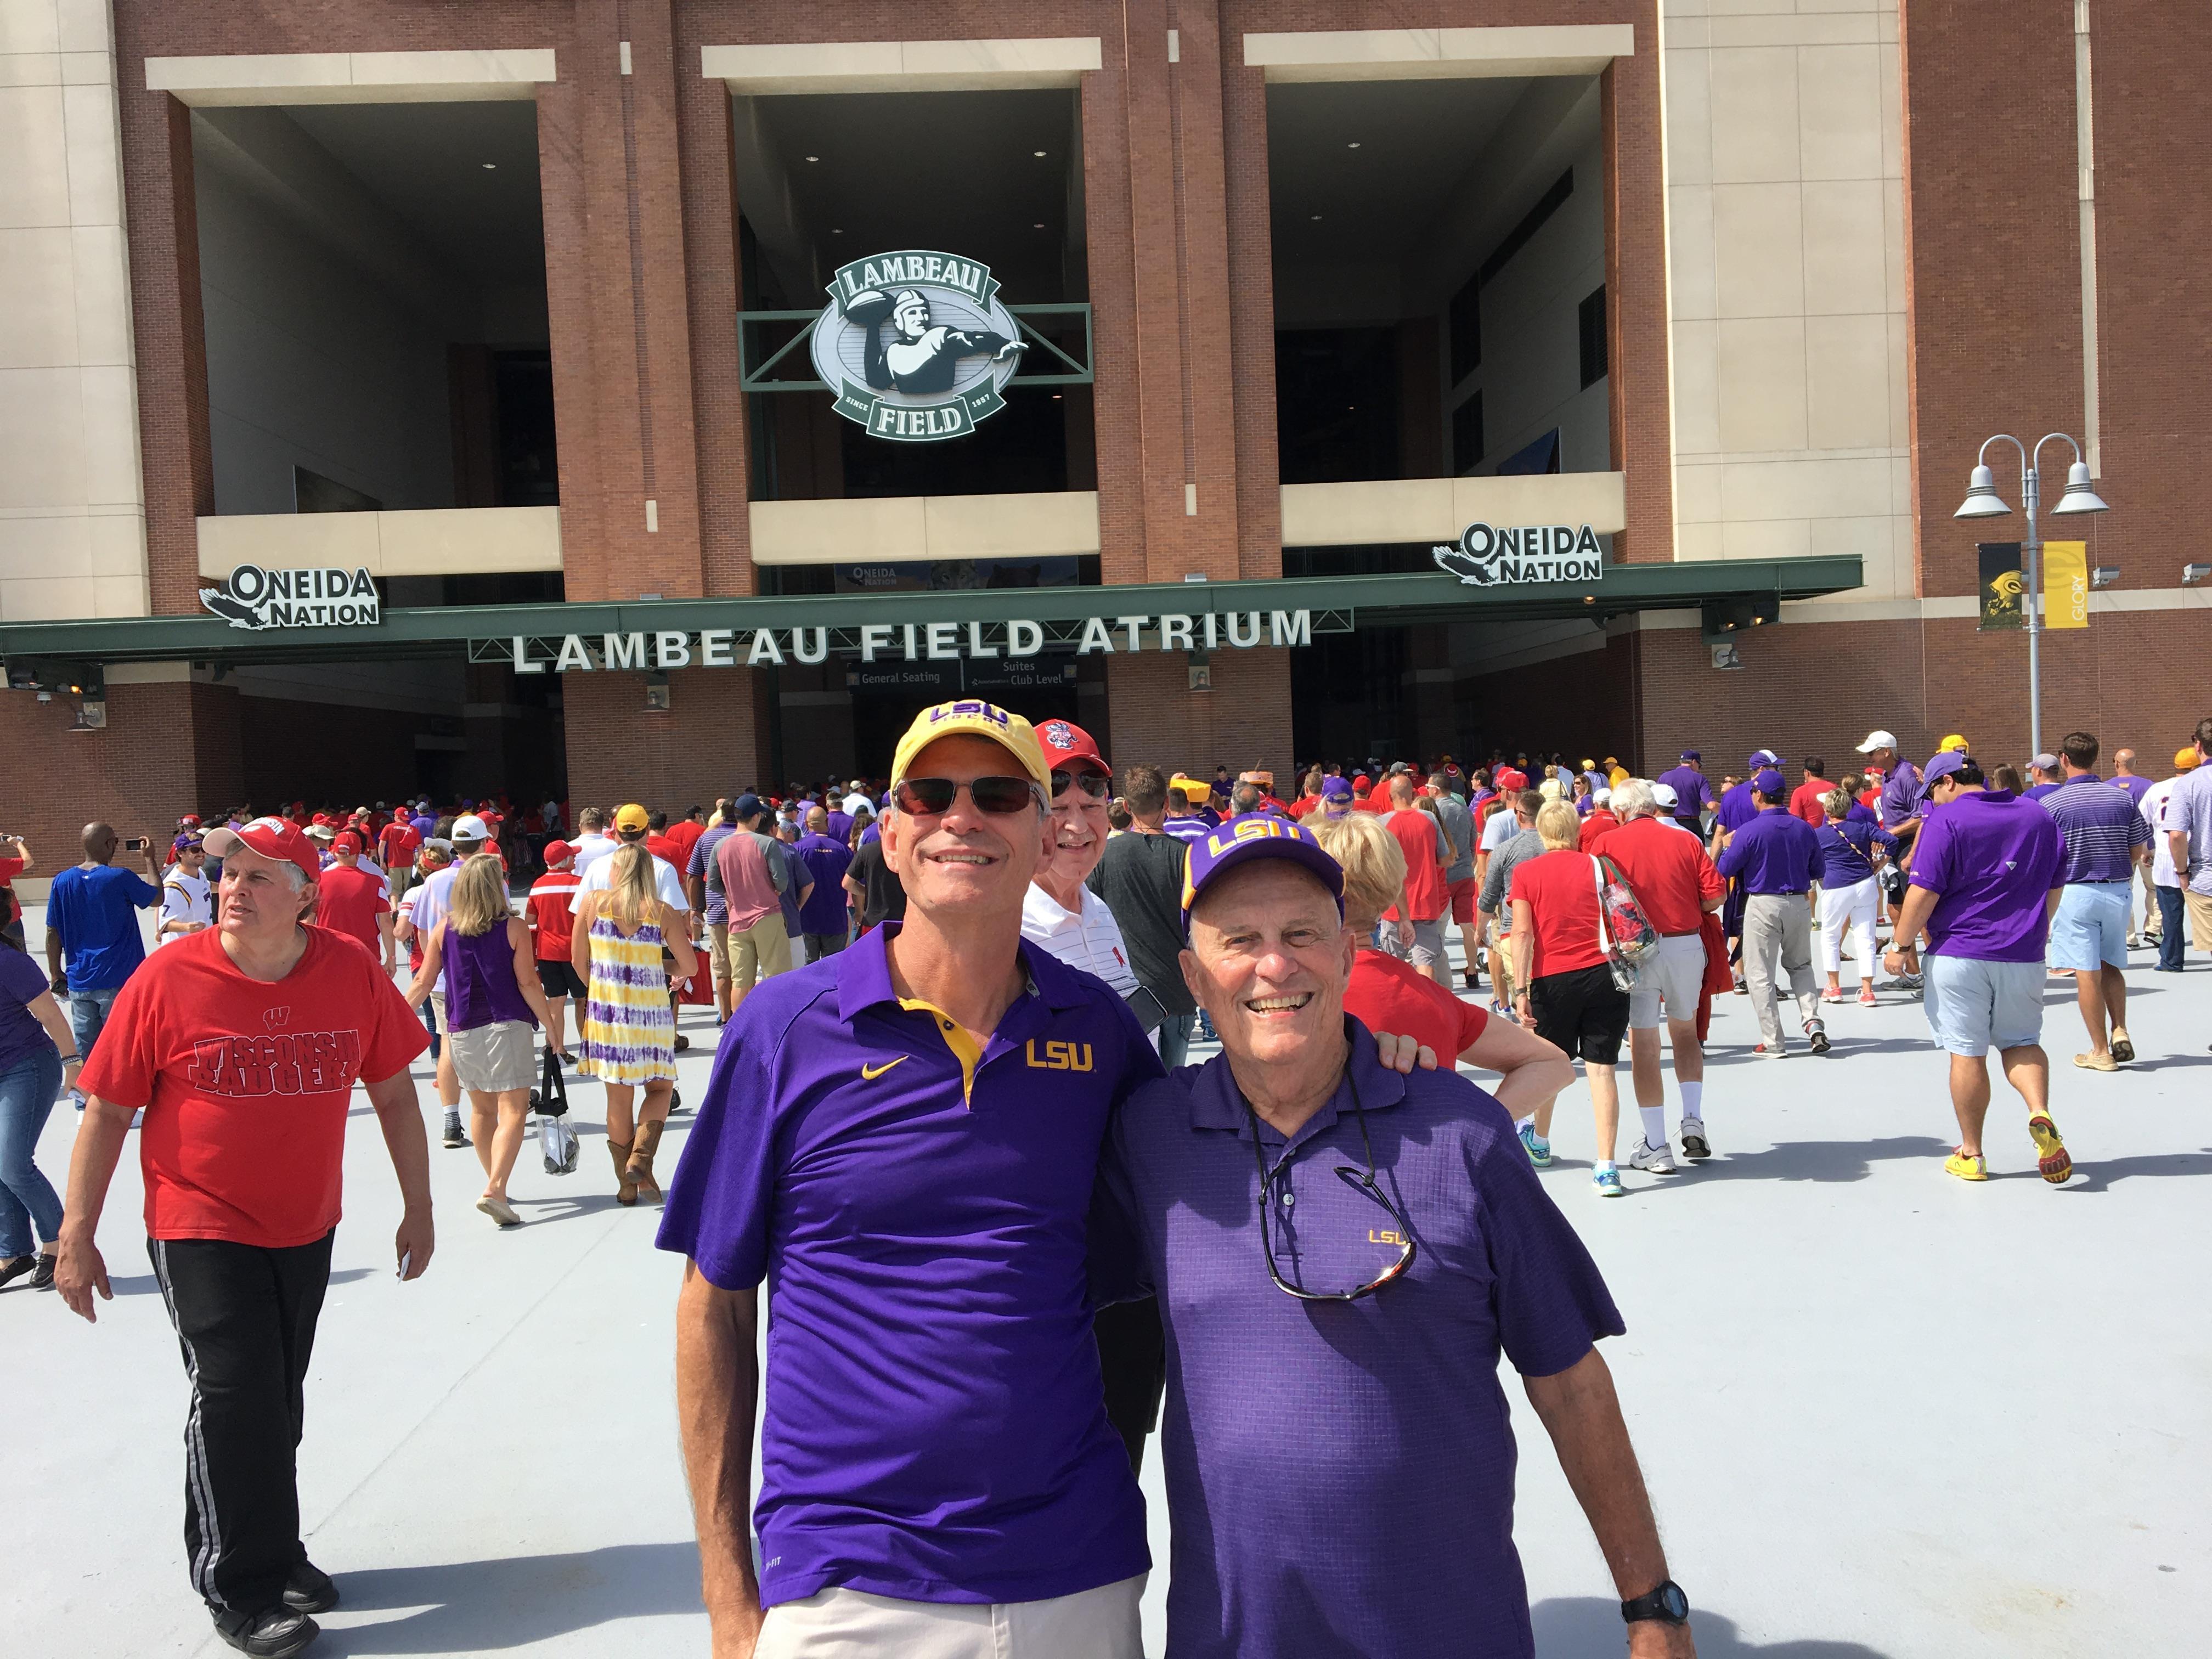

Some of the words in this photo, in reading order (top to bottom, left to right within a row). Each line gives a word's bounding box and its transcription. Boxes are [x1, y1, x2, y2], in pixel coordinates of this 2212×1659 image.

[842, 256, 981, 297] LAMBEAU
[845, 396, 868, 411] SINCE
[972, 393, 990, 408] 1957
[876, 407, 962, 436] FIELD
[1463, 523, 1599, 558] ONEIDA
[853, 567, 896, 579] ONEIDA
[1499, 560, 1600, 581] NATION
[231, 565, 375, 601] ONEIDA
[2072, 574, 2085, 622] GLORY
[270, 602, 376, 625] NATION
[512, 627, 827, 674] LAMBEAU
[860, 619, 1043, 662] FIELD
[1077, 609, 1312, 655] ATRIUM
[862, 673, 899, 684] General
[902, 672, 940, 684] Seating
[1003, 662, 1035, 672] Suites
[1011, 675, 1032, 685] Club
[1036, 674, 1062, 684] Level
[930, 702, 1008, 724] LSU
[162, 904, 171, 917] 7
[263, 1006, 290, 1030] W
[1026, 1039, 1093, 1073] LSU
